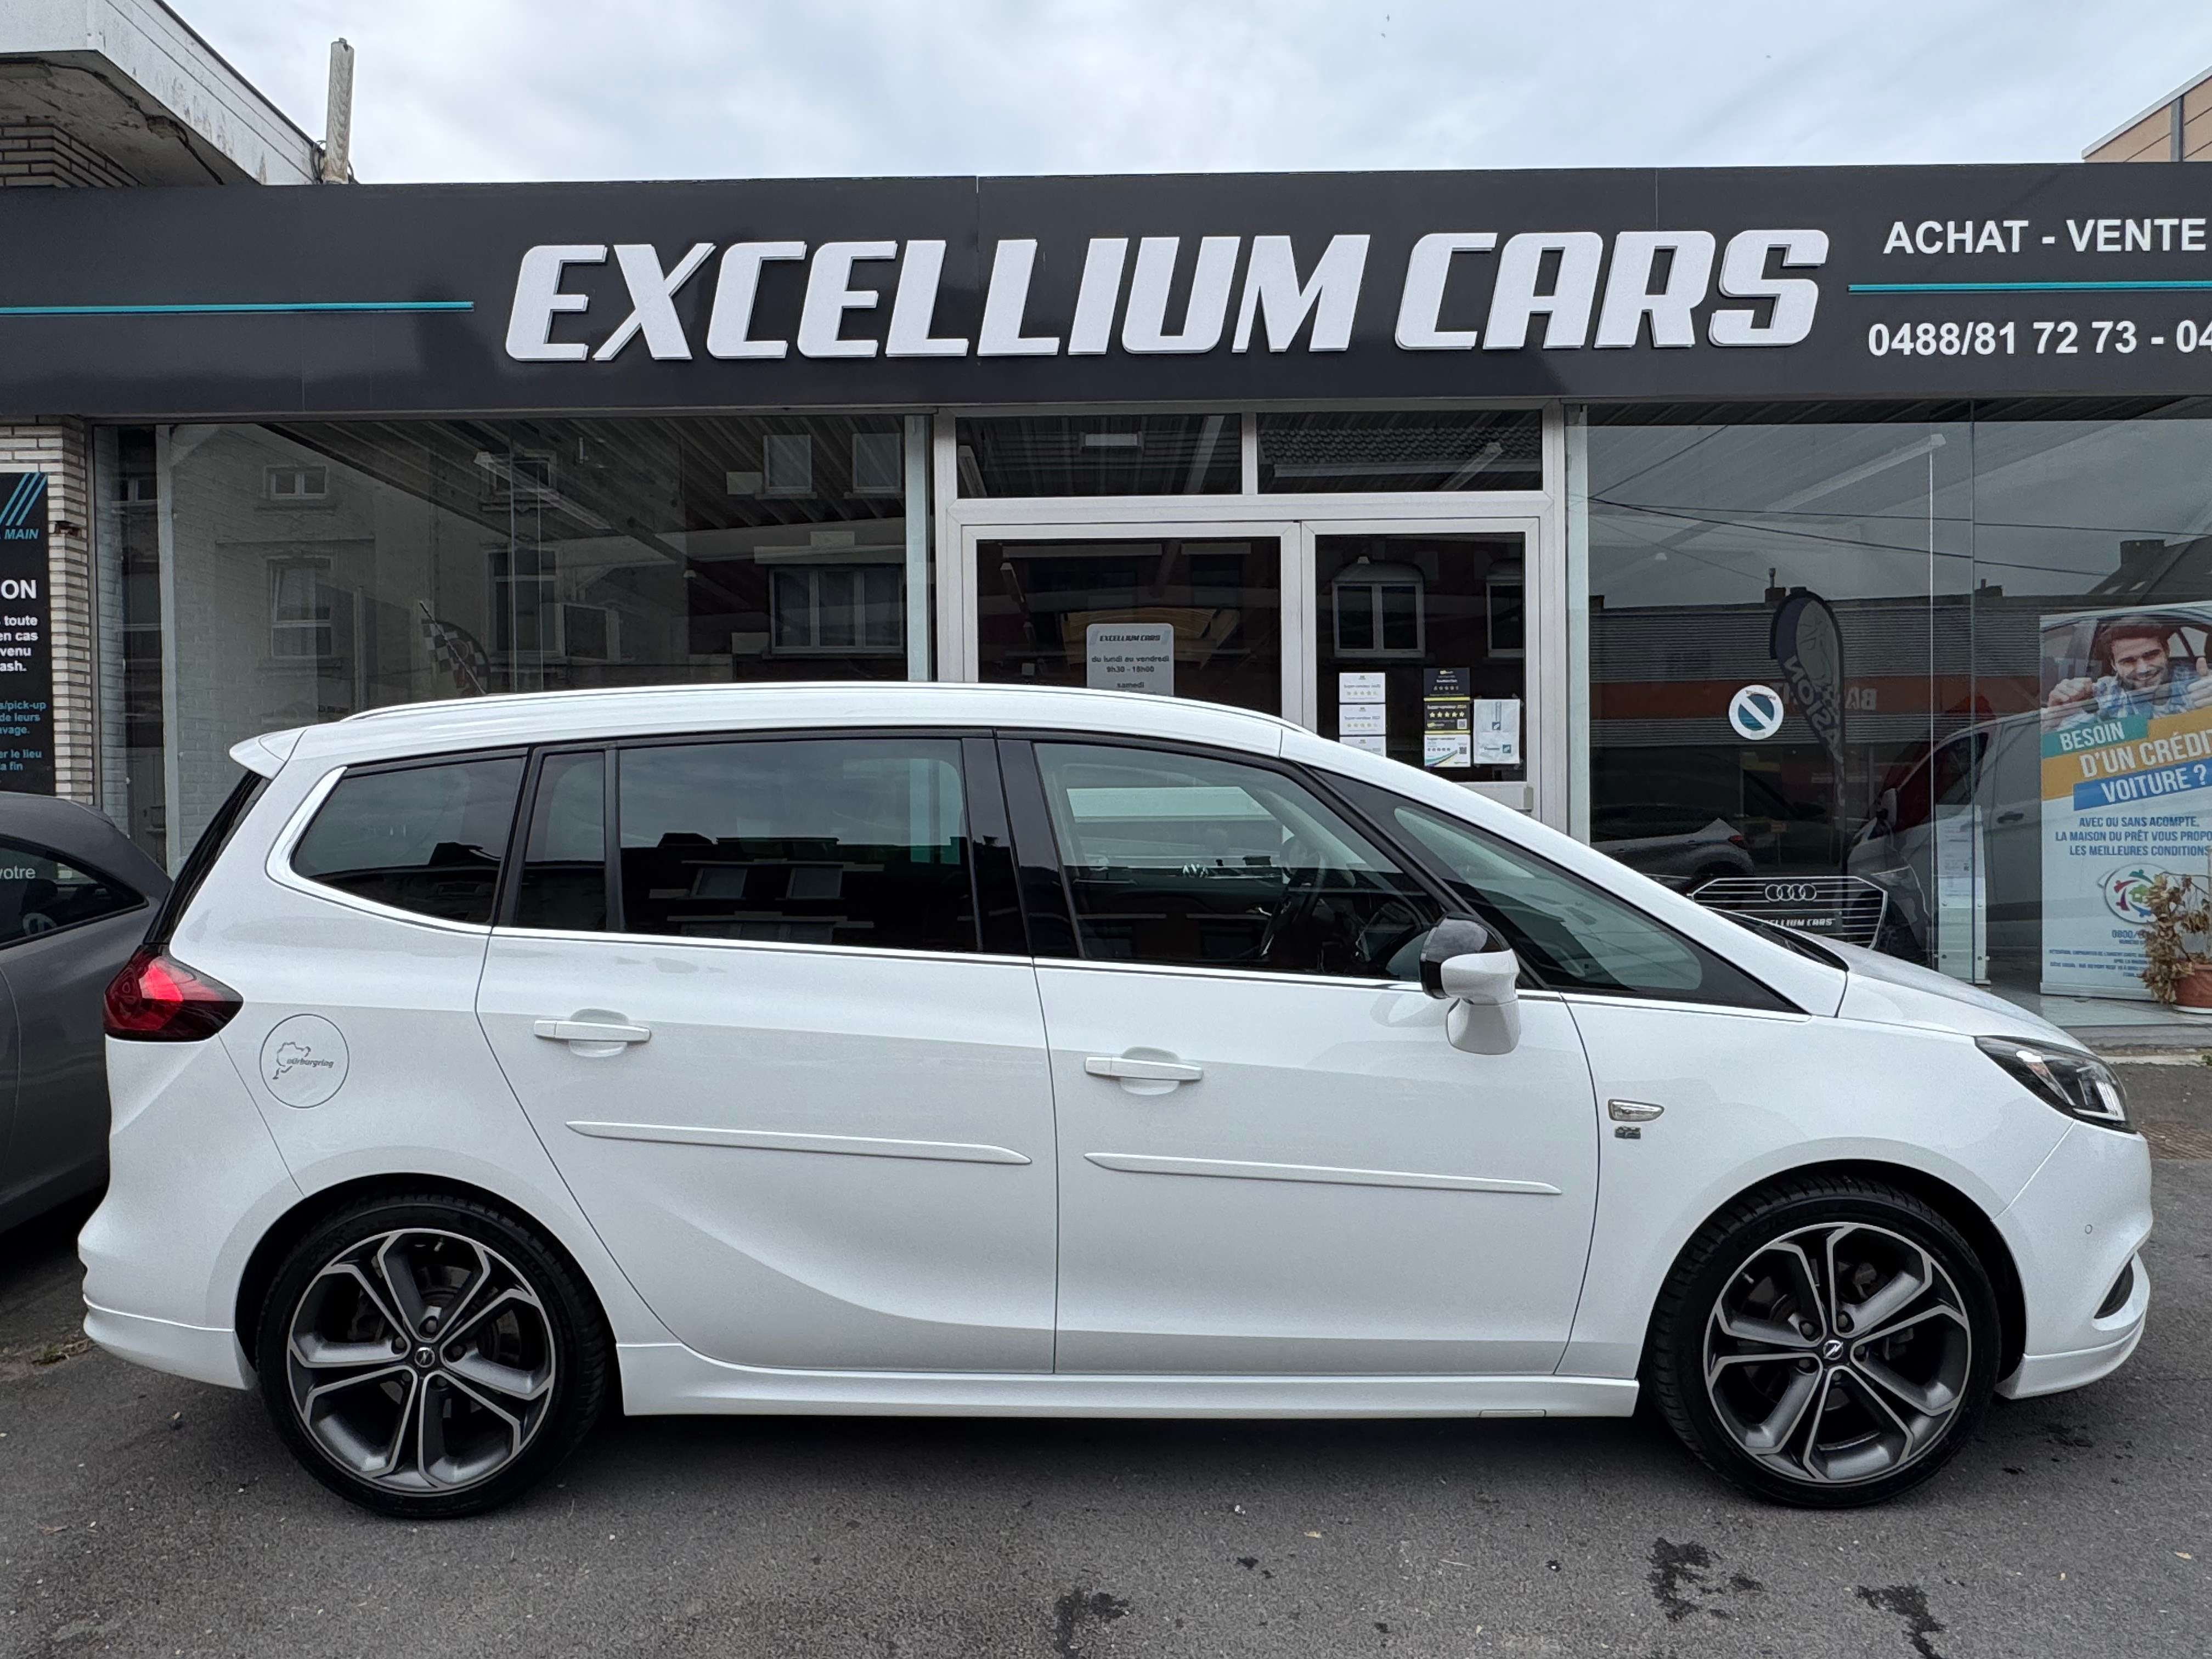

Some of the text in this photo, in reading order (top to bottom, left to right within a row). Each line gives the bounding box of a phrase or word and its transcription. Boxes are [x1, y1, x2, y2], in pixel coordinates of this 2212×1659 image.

[1883, 218, 2207, 254] ACHAT - VENTE
[505, 230, 1829, 362] EXCELLIUM CARS
[1868, 319, 2212, 356] 0488/81 72 73 - 04
[4, 528, 40, 540] MAIN
[4, 616, 38, 627] toute
[15, 632, 38, 641] cas
[0, 647, 32, 656] venu
[14, 713, 41, 722] leurs
[2059, 721, 2125, 752] BESOIN
[11, 749, 20, 758] le
[22, 748, 43, 758] lieu
[9, 761, 24, 771] fin
[2079, 745, 2136, 778] D'UN
[2101, 763, 2208, 804] VOITURE ?
[2079, 816, 2103, 828] AVEC
[2106, 816, 2120, 828] OU
[2121, 816, 2147, 828] SANS
[2055, 831, 2067, 842] LA
[2069, 831, 2107, 842] MAISON
[2109, 831, 2122, 842] DU
[2124, 829, 2149, 842] PRÊT
[2151, 831, 2178, 842] VOUS
[2069, 845, 2087, 856] LES
[2089, 845, 2148, 856] MEILLEURES
